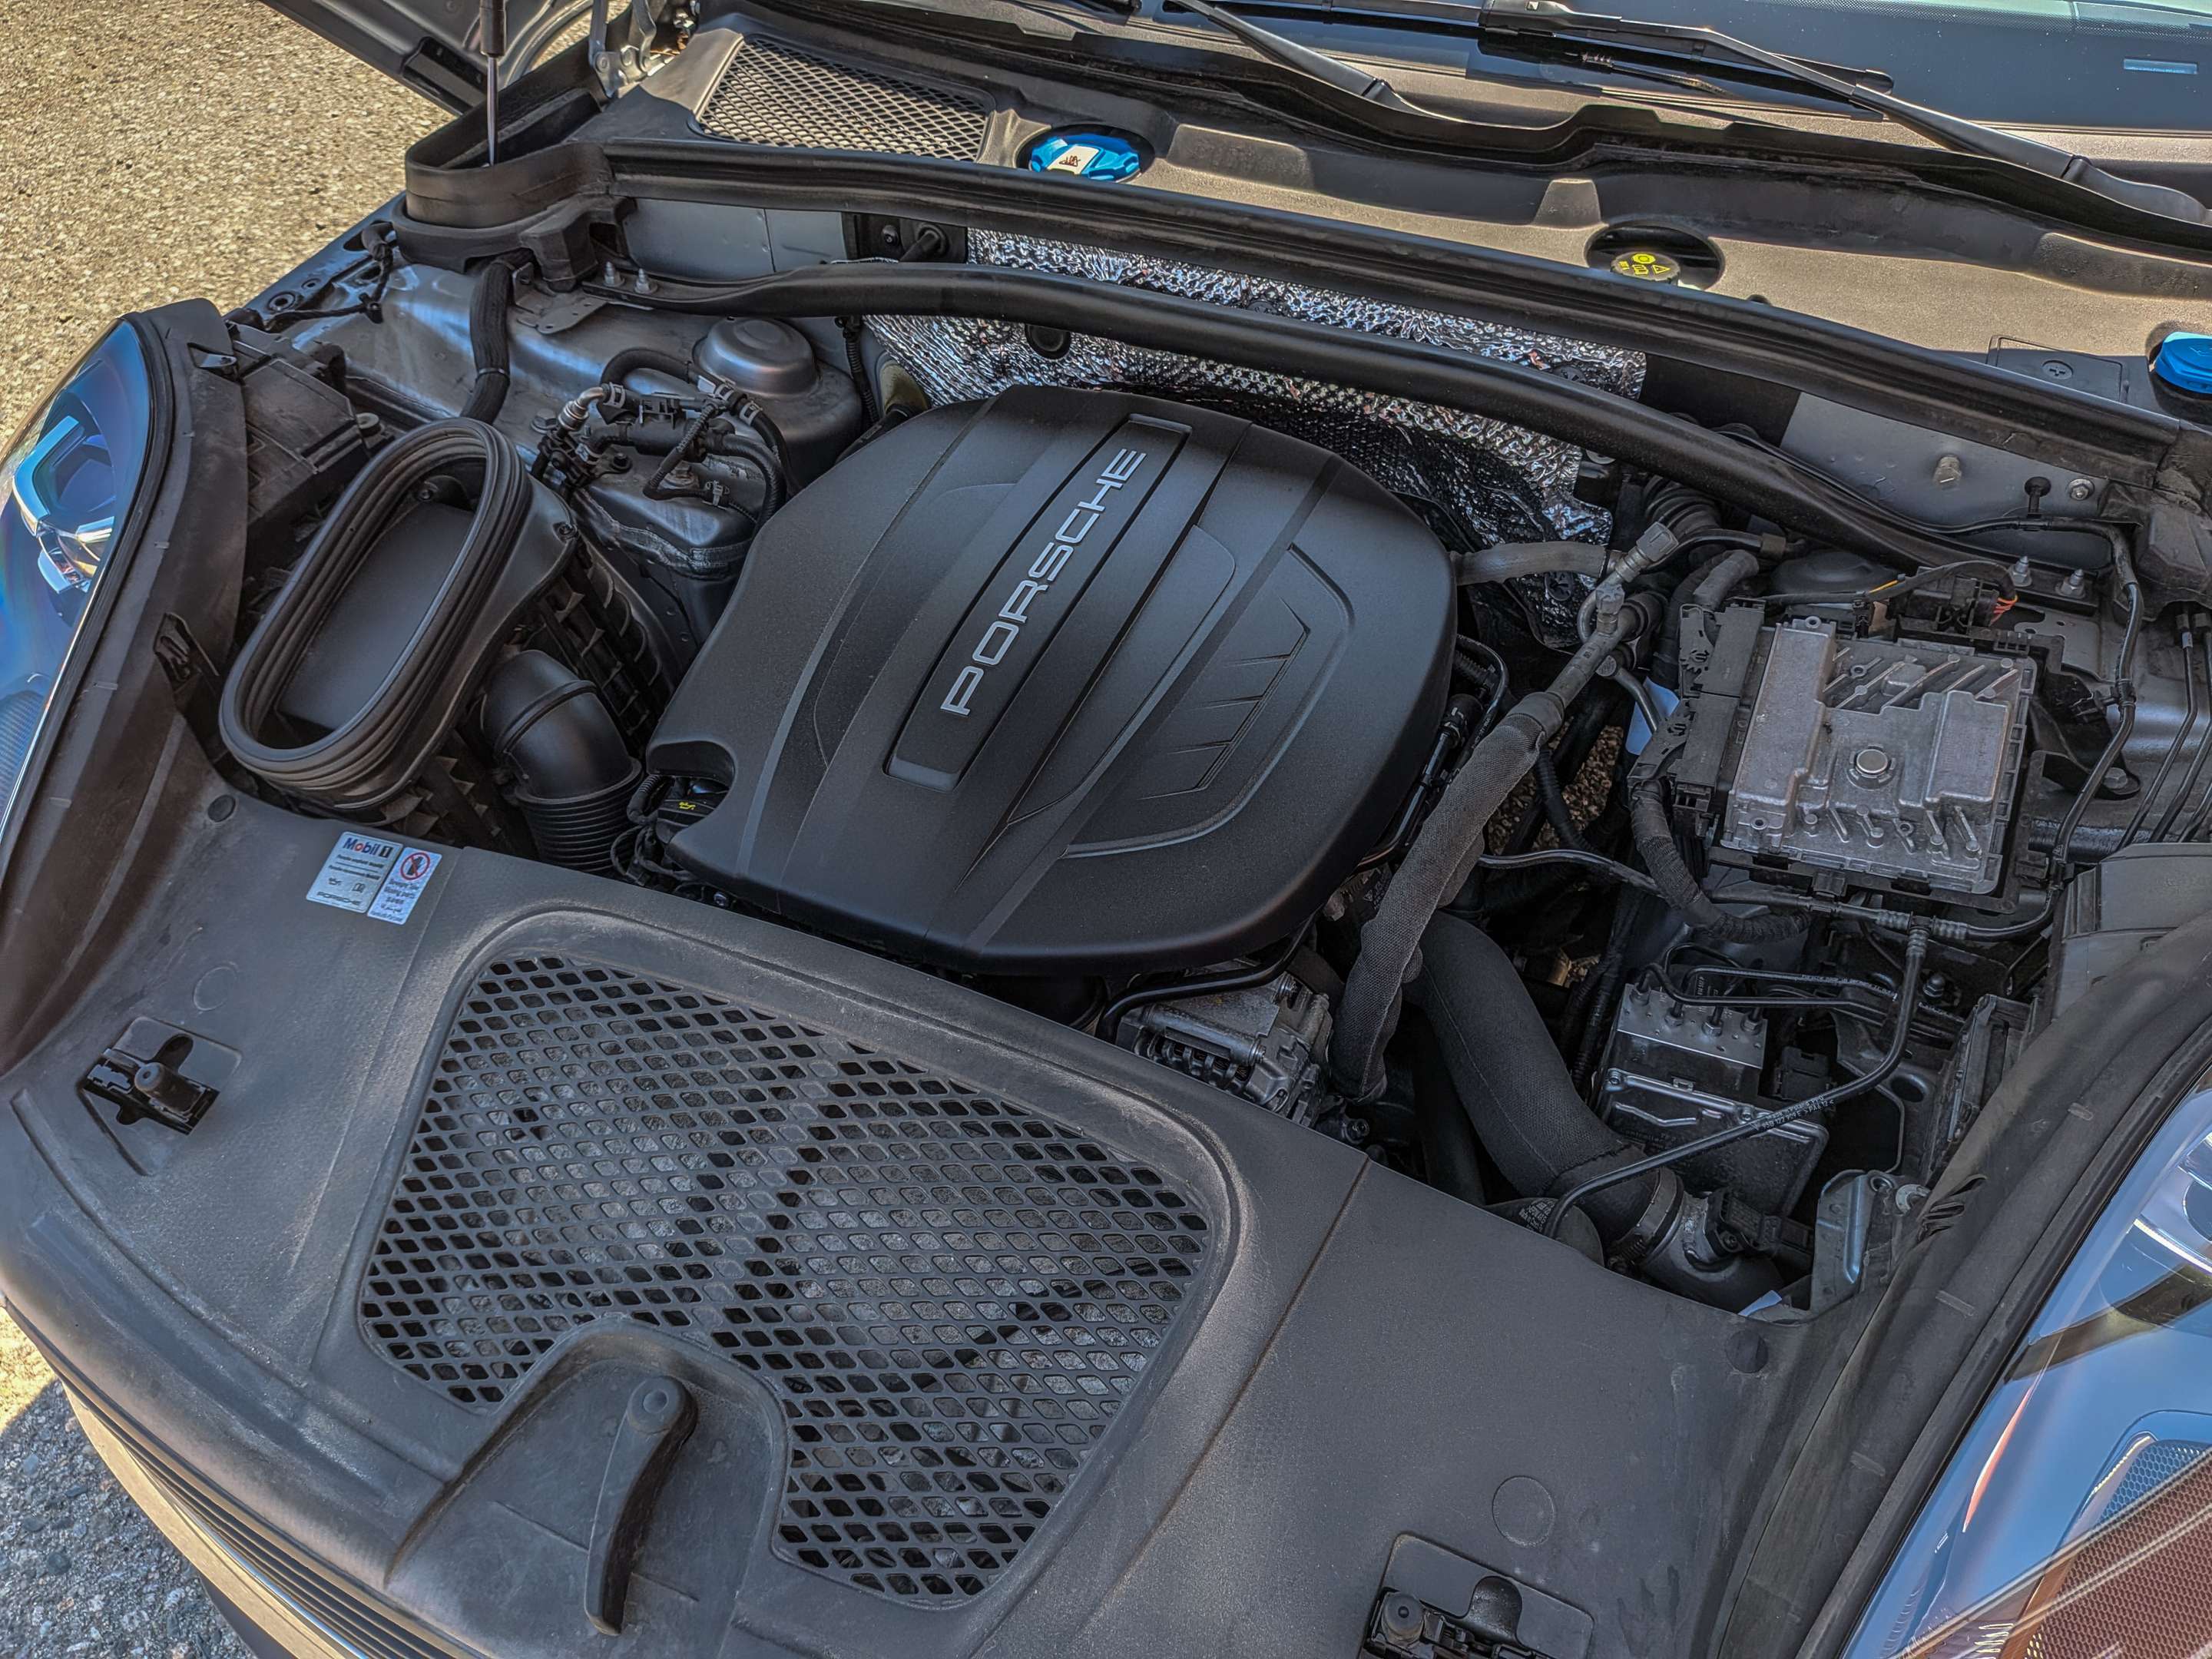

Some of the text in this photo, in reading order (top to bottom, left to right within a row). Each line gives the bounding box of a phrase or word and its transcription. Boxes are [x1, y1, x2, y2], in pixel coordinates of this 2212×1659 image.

[940, 449, 1147, 716] PORSCHE
[343, 837, 393, 858] Mobil 1
